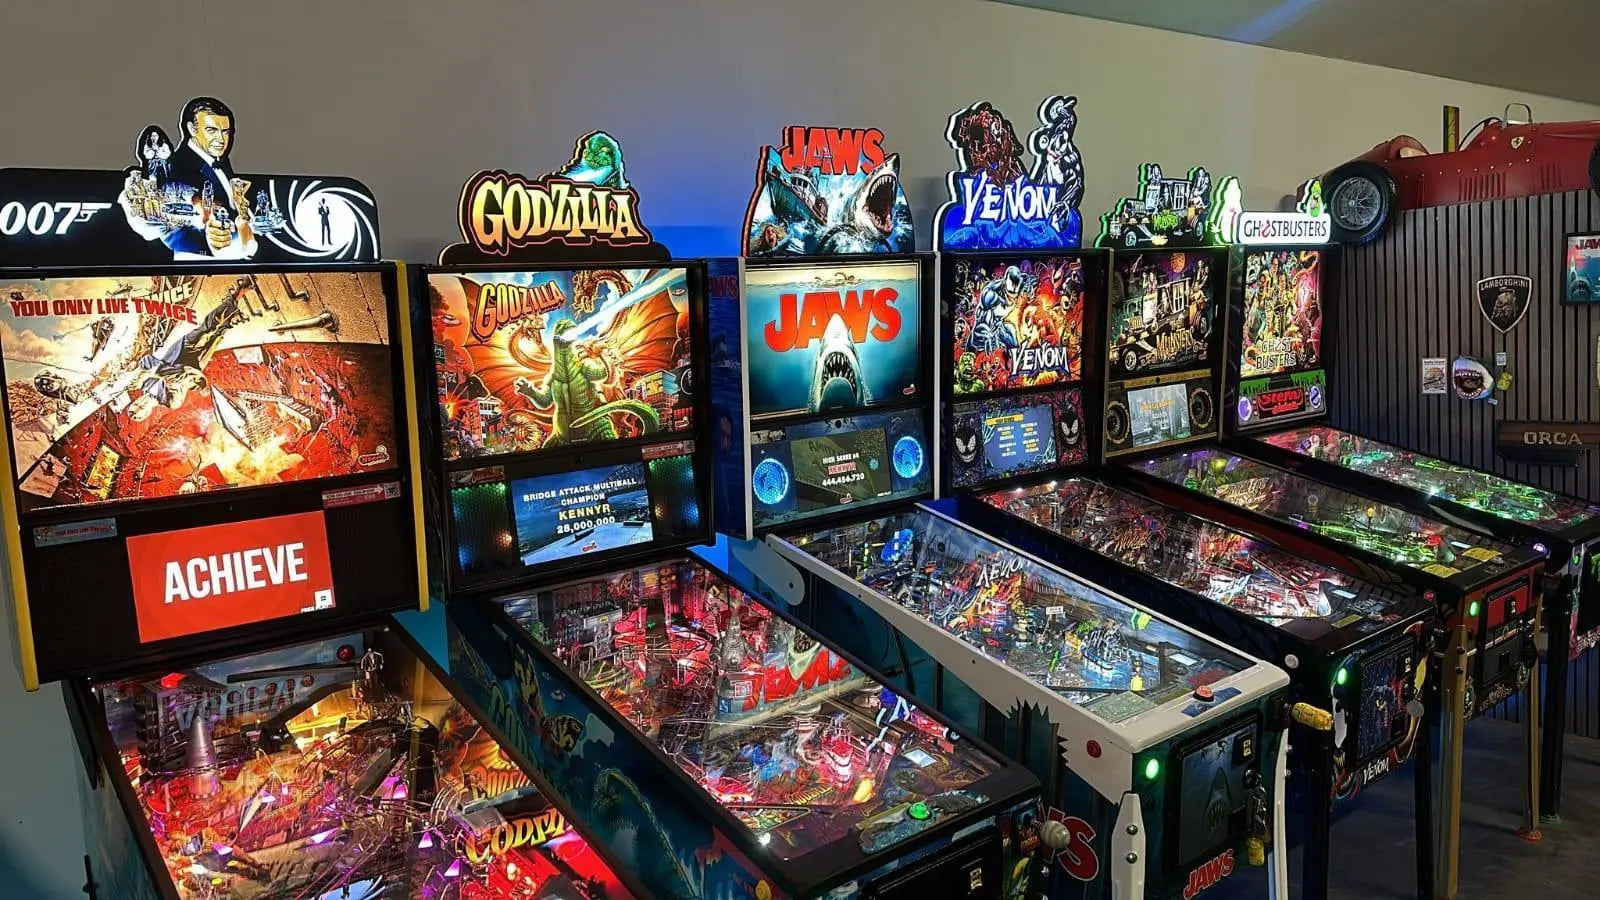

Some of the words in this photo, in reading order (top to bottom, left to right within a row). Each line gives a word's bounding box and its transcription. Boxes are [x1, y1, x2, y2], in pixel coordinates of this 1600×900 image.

[782, 126, 887, 175] JAWS
[962, 169, 1060, 225] VENOM
[0, 201, 84, 236] 007
[472, 179, 643, 247] GODZILLA
[1243, 219, 1328, 239] GHOSTBUSTERS
[1480, 278, 1529, 291] LAMBORGHINI
[10, 300, 49, 317] YOU
[53, 298, 94, 316] ONLY
[97, 297, 130, 314] LIVE
[131, 297, 198, 325] TWICE
[474, 279, 567, 340] GODZILLA
[763, 287, 902, 353] JAWS
[1010, 341, 1071, 377] VENOM
[1256, 351, 1297, 369] BUSTERS
[1523, 431, 1583, 445] ORCA
[523, 490, 556, 502] BRIDGE
[559, 485, 591, 496] ATTACK
[593, 477, 637, 491] MULTIBALL
[561, 492, 606, 506] CHAMPION
[556, 516, 616, 535] 28,000,000
[558, 503, 611, 521] KENNYR
[164, 542, 308, 604] ACHIEVE
[1363, 756, 1390, 785] VENOM
[1183, 848, 1235, 900] JAWS
